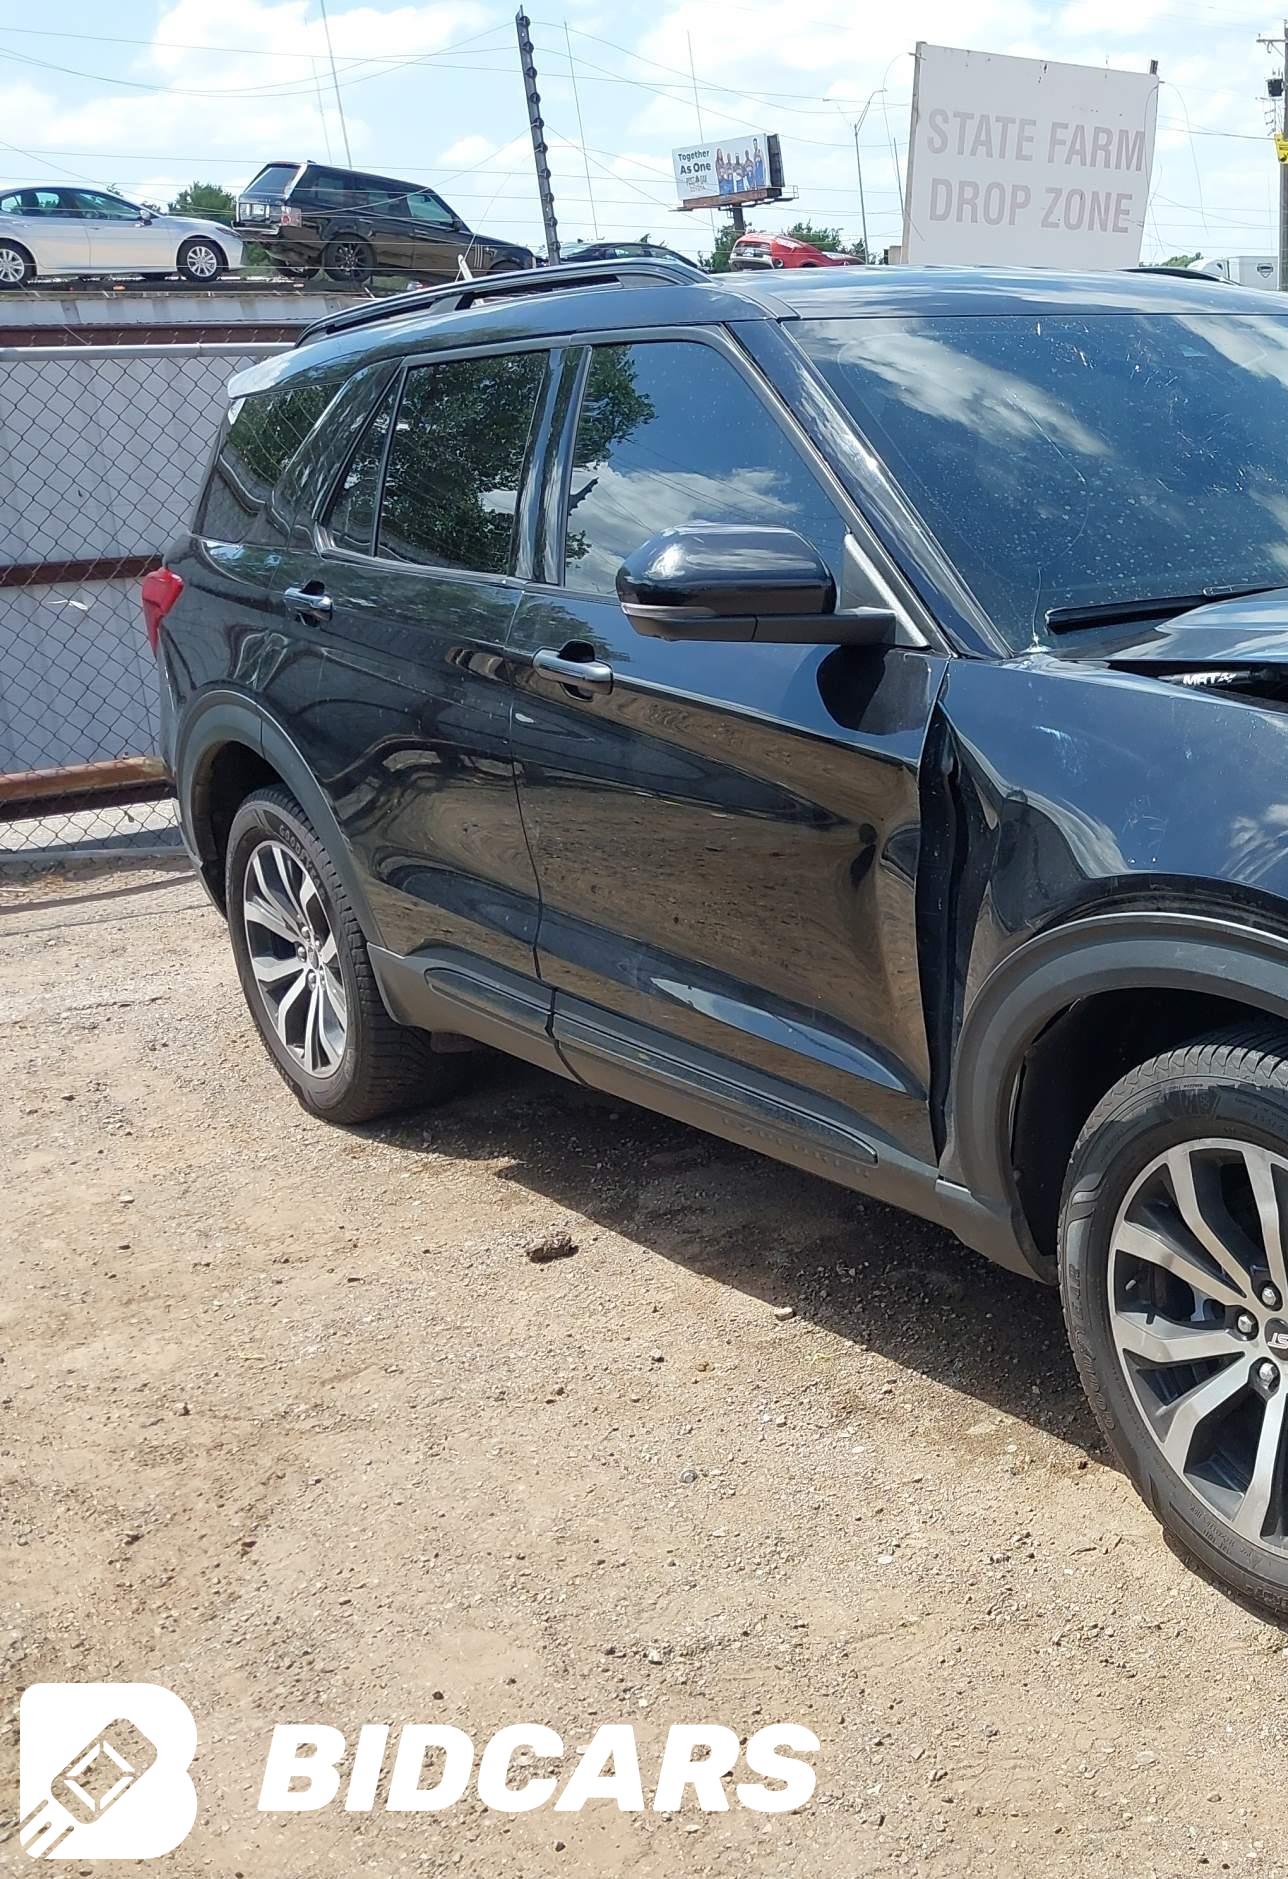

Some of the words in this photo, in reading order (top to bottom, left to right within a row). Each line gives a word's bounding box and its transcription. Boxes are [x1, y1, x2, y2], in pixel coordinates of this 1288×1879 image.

[678, 150, 710, 162] Together
[927, 108, 1037, 161] STATE
[1047, 122, 1145, 172] FARM
[680, 164, 692, 175] As
[693, 162, 711, 173] One
[929, 177, 1032, 226] DROP
[1040, 187, 1133, 233] ZONE
